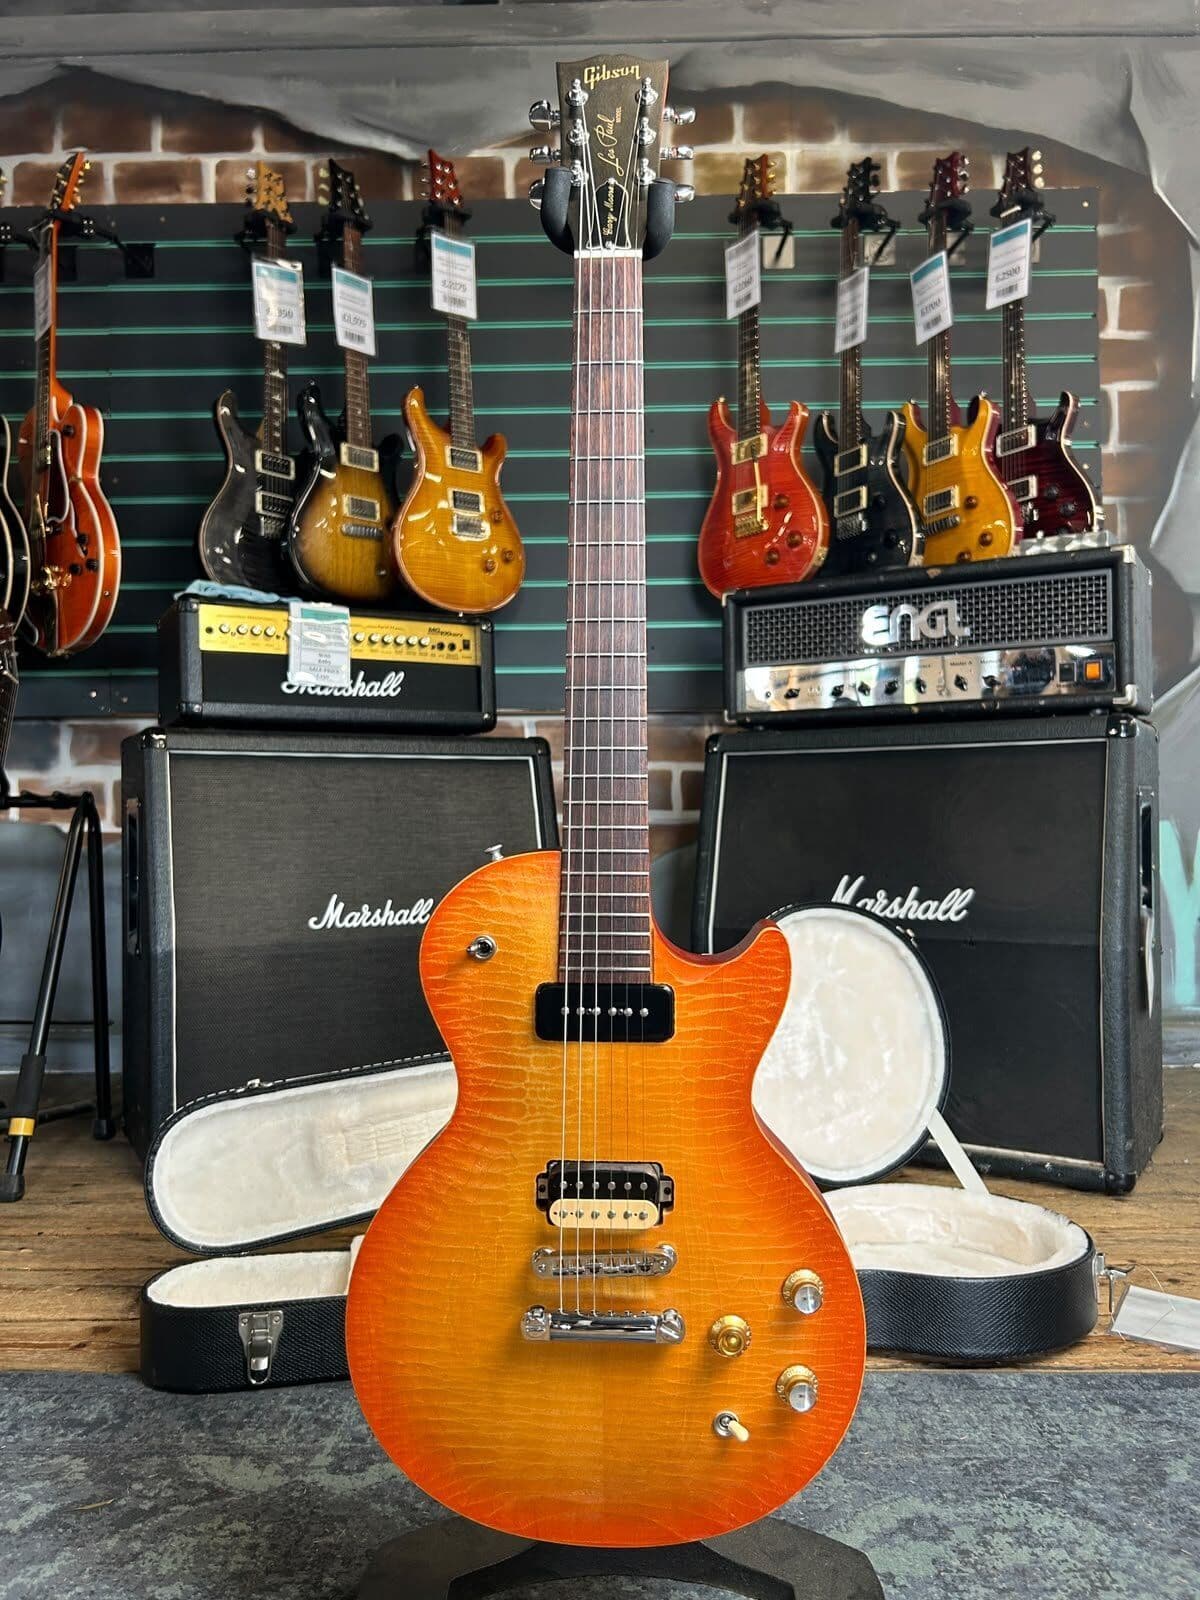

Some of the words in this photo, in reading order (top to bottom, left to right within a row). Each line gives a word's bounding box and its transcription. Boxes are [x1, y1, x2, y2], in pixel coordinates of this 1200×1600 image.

[583, 64, 641, 90] Gibson
[594, 113, 618, 147] Paul
[597, 148, 624, 176] Les
[862, 599, 971, 646] ENGL
[308, 893, 434, 930] Marshall
[831, 874, 976, 922] Marshall
